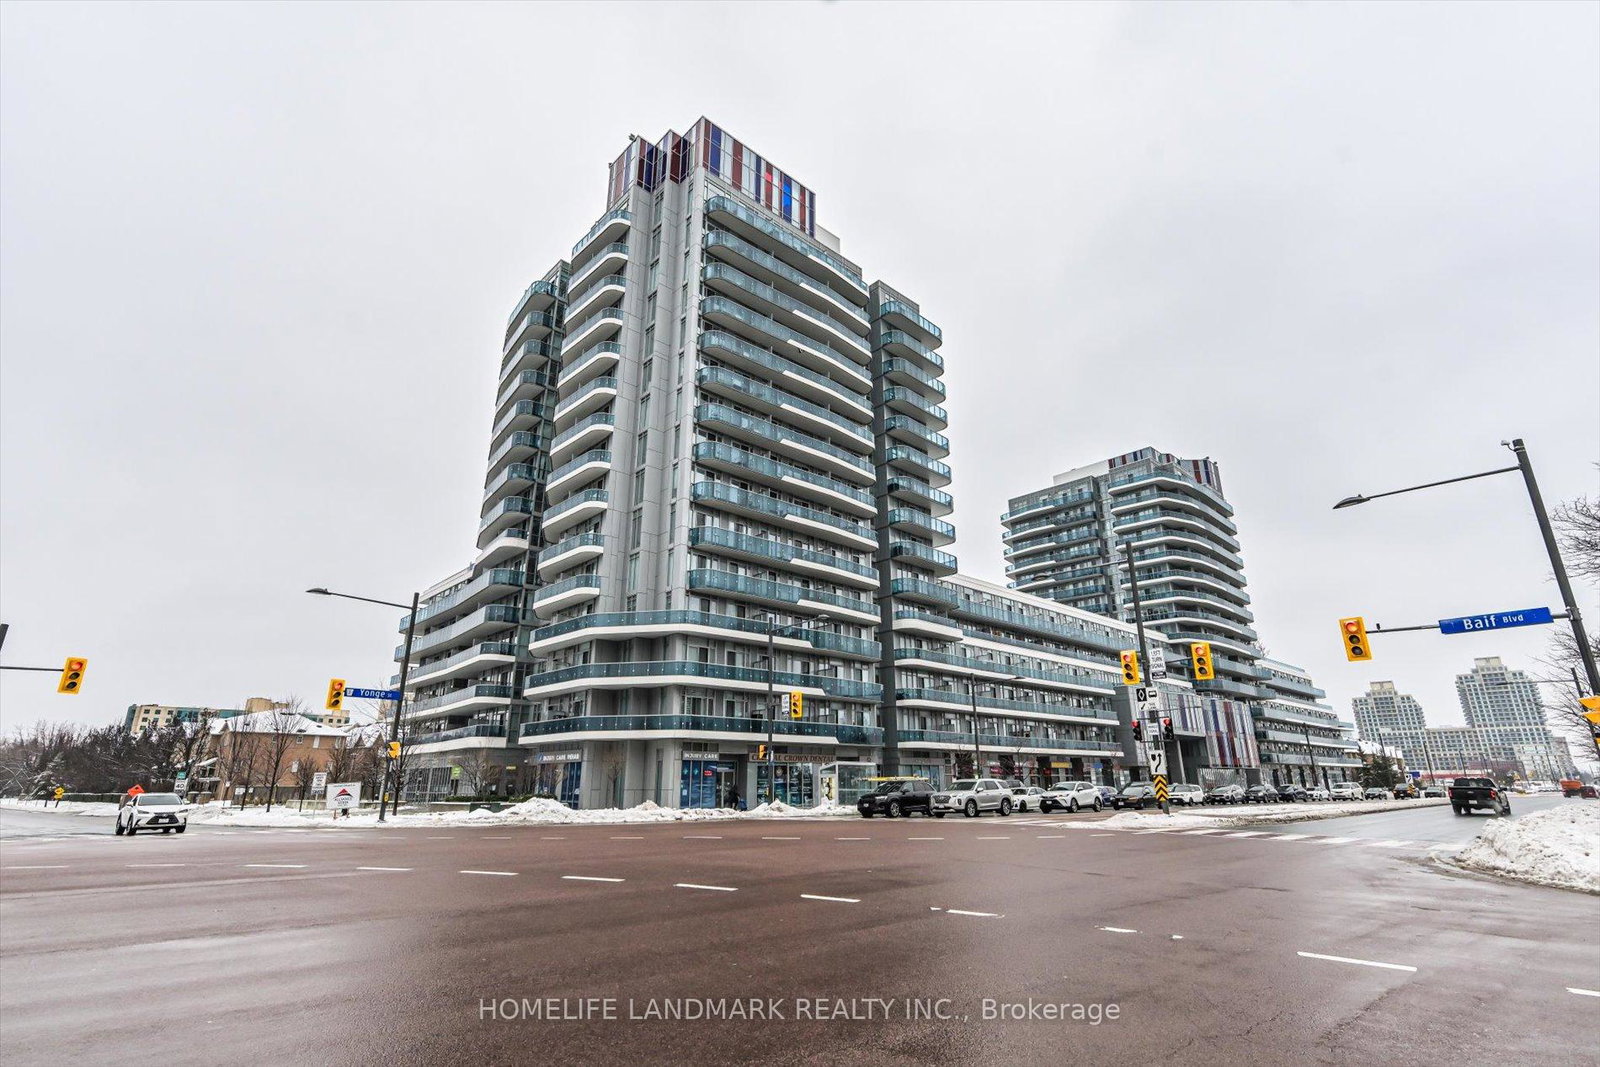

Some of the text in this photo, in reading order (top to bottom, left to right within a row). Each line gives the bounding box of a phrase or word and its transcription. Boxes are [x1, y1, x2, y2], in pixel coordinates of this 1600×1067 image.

[1462, 614, 1524, 630] Baif Blvd
[360, 689, 386, 698] Yonge
